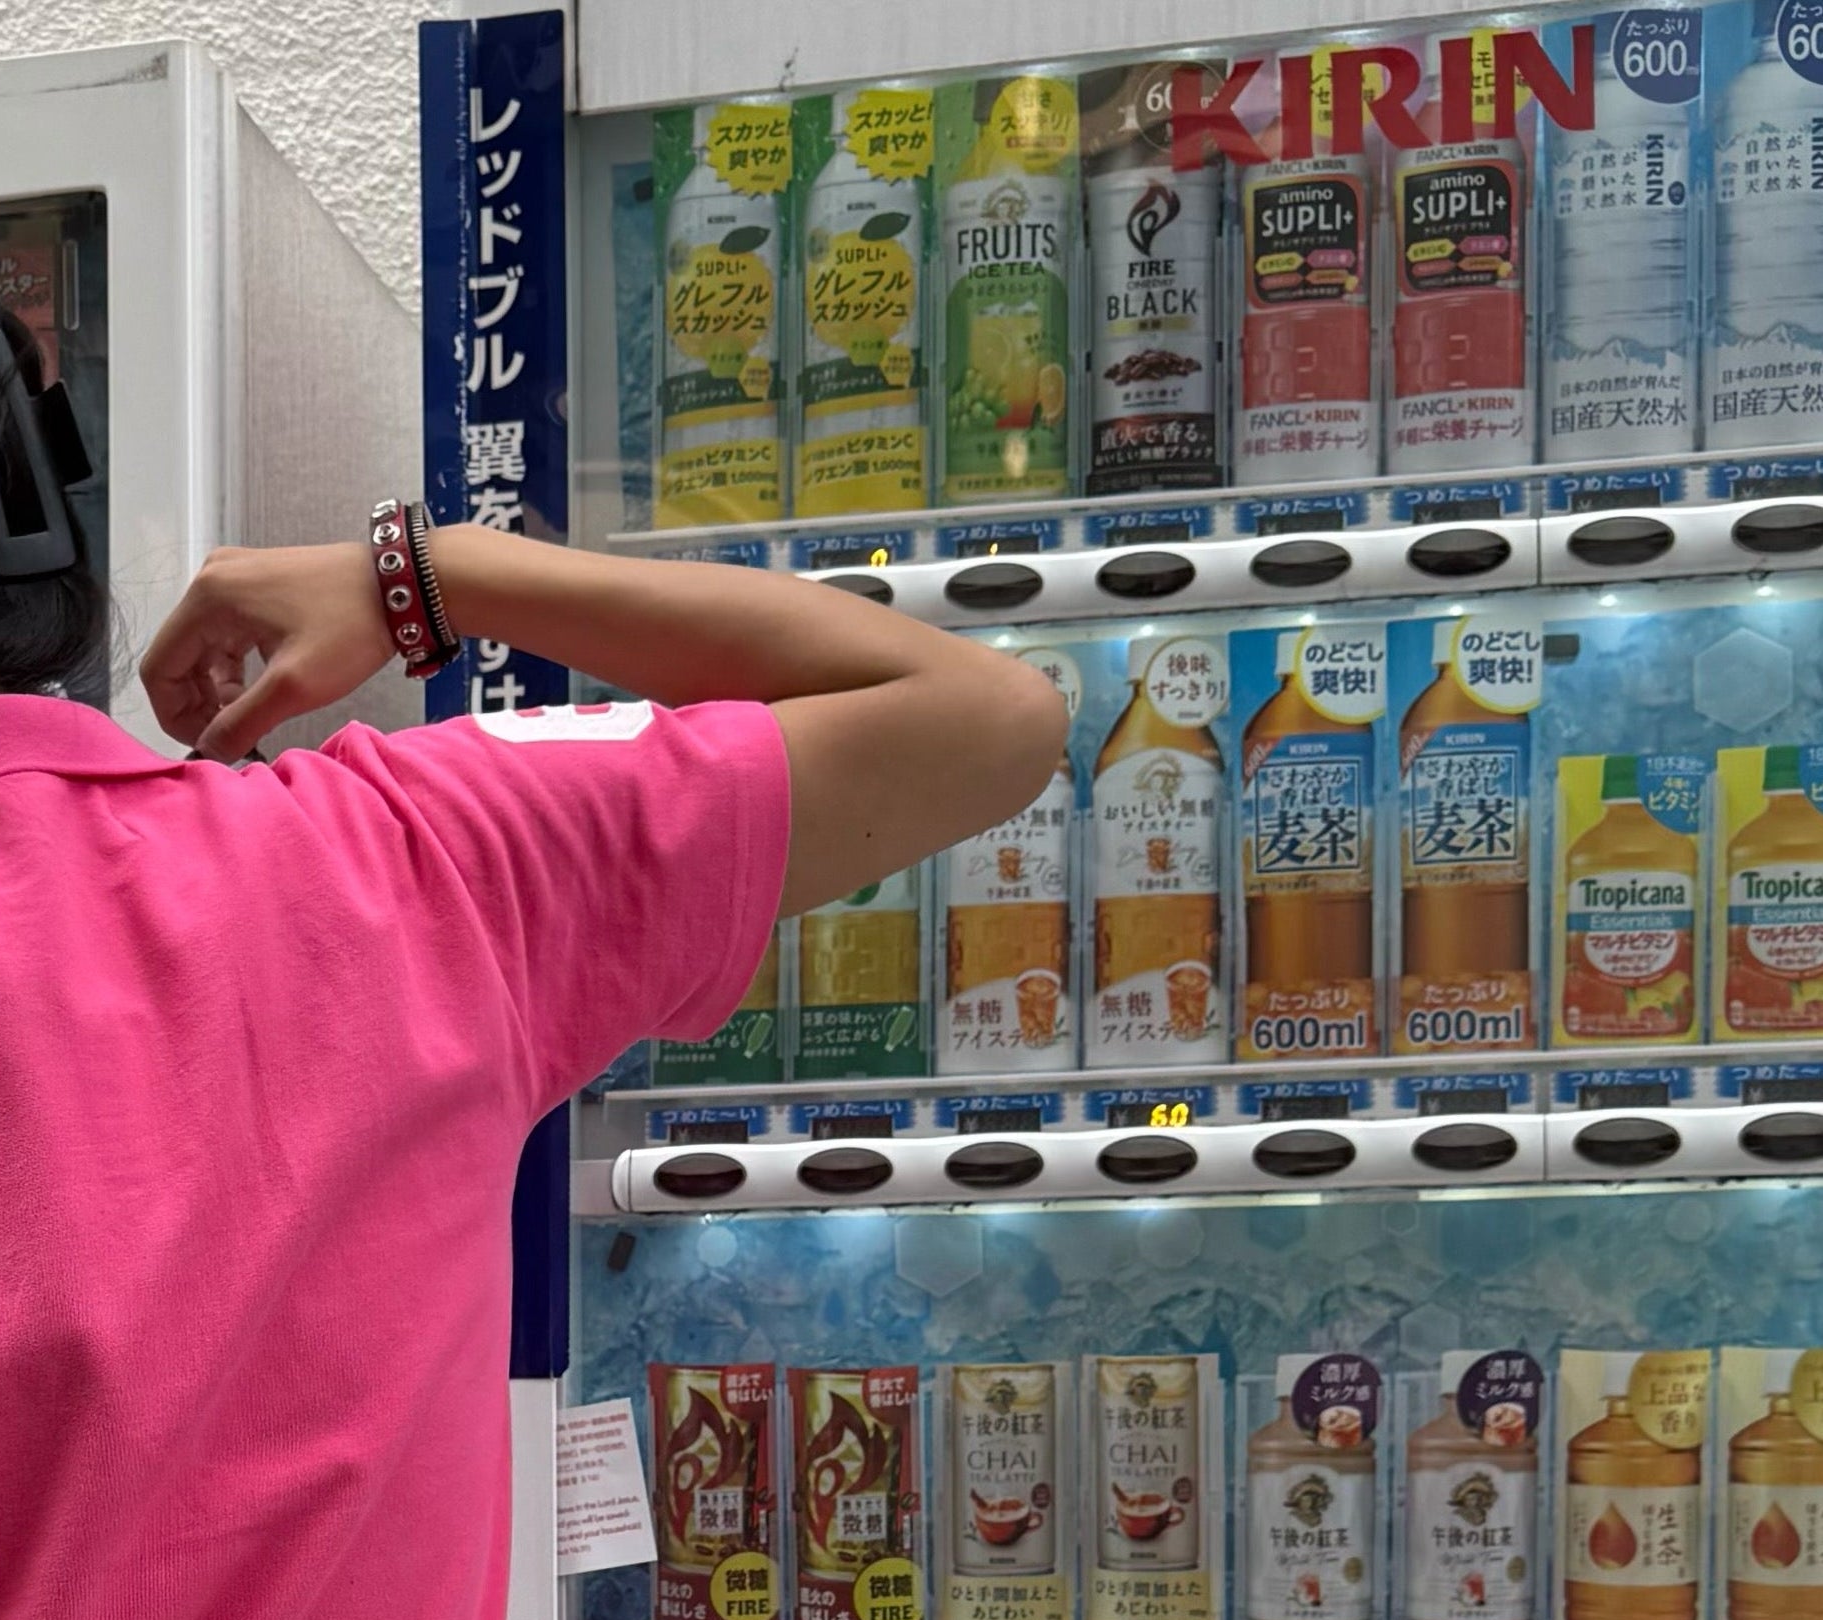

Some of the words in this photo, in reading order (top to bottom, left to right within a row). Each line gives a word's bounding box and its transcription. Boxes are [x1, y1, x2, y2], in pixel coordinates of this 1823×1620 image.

[1171, 24, 1594, 172] KIRIN
[1582, 152, 1636, 172] 自然が
[1646, 133, 1663, 206] KIRIN
[1430, 172, 1486, 190] amino
[1278, 186, 1334, 204] amino
[1582, 190, 1637, 210] 天然水
[468, 87, 524, 393] レッドブル
[957, 223, 1056, 265] FRUITS
[1127, 259, 1176, 279] FIRE
[1106, 289, 1198, 321] BLACK
[1551, 401, 1687, 437] 国産天然水
[1306, 643, 1383, 664] のどごし
[1462, 632, 1539, 652] のどごし
[1312, 666, 1376, 695] 爽快!
[1469, 656, 1533, 686] 爽快!
[1260, 808, 1358, 866] 麦茶
[1418, 800, 1514, 857] 麦茶
[1580, 879, 1684, 907] Tropicana
[1269, 992, 1350, 1010] たっぷり
[1424, 982, 1507, 1004] たっぷり
[1254, 1015, 1364, 1051] 600ml
[1409, 1008, 1522, 1044] 600ml
[968, 1450, 1036, 1470] CHAI
[1109, 1444, 1177, 1464] CHAI
[726, 1570, 769, 1593] 微糖
[869, 1576, 911, 1599] 微糖
[727, 1599, 769, 1617] FIRE
